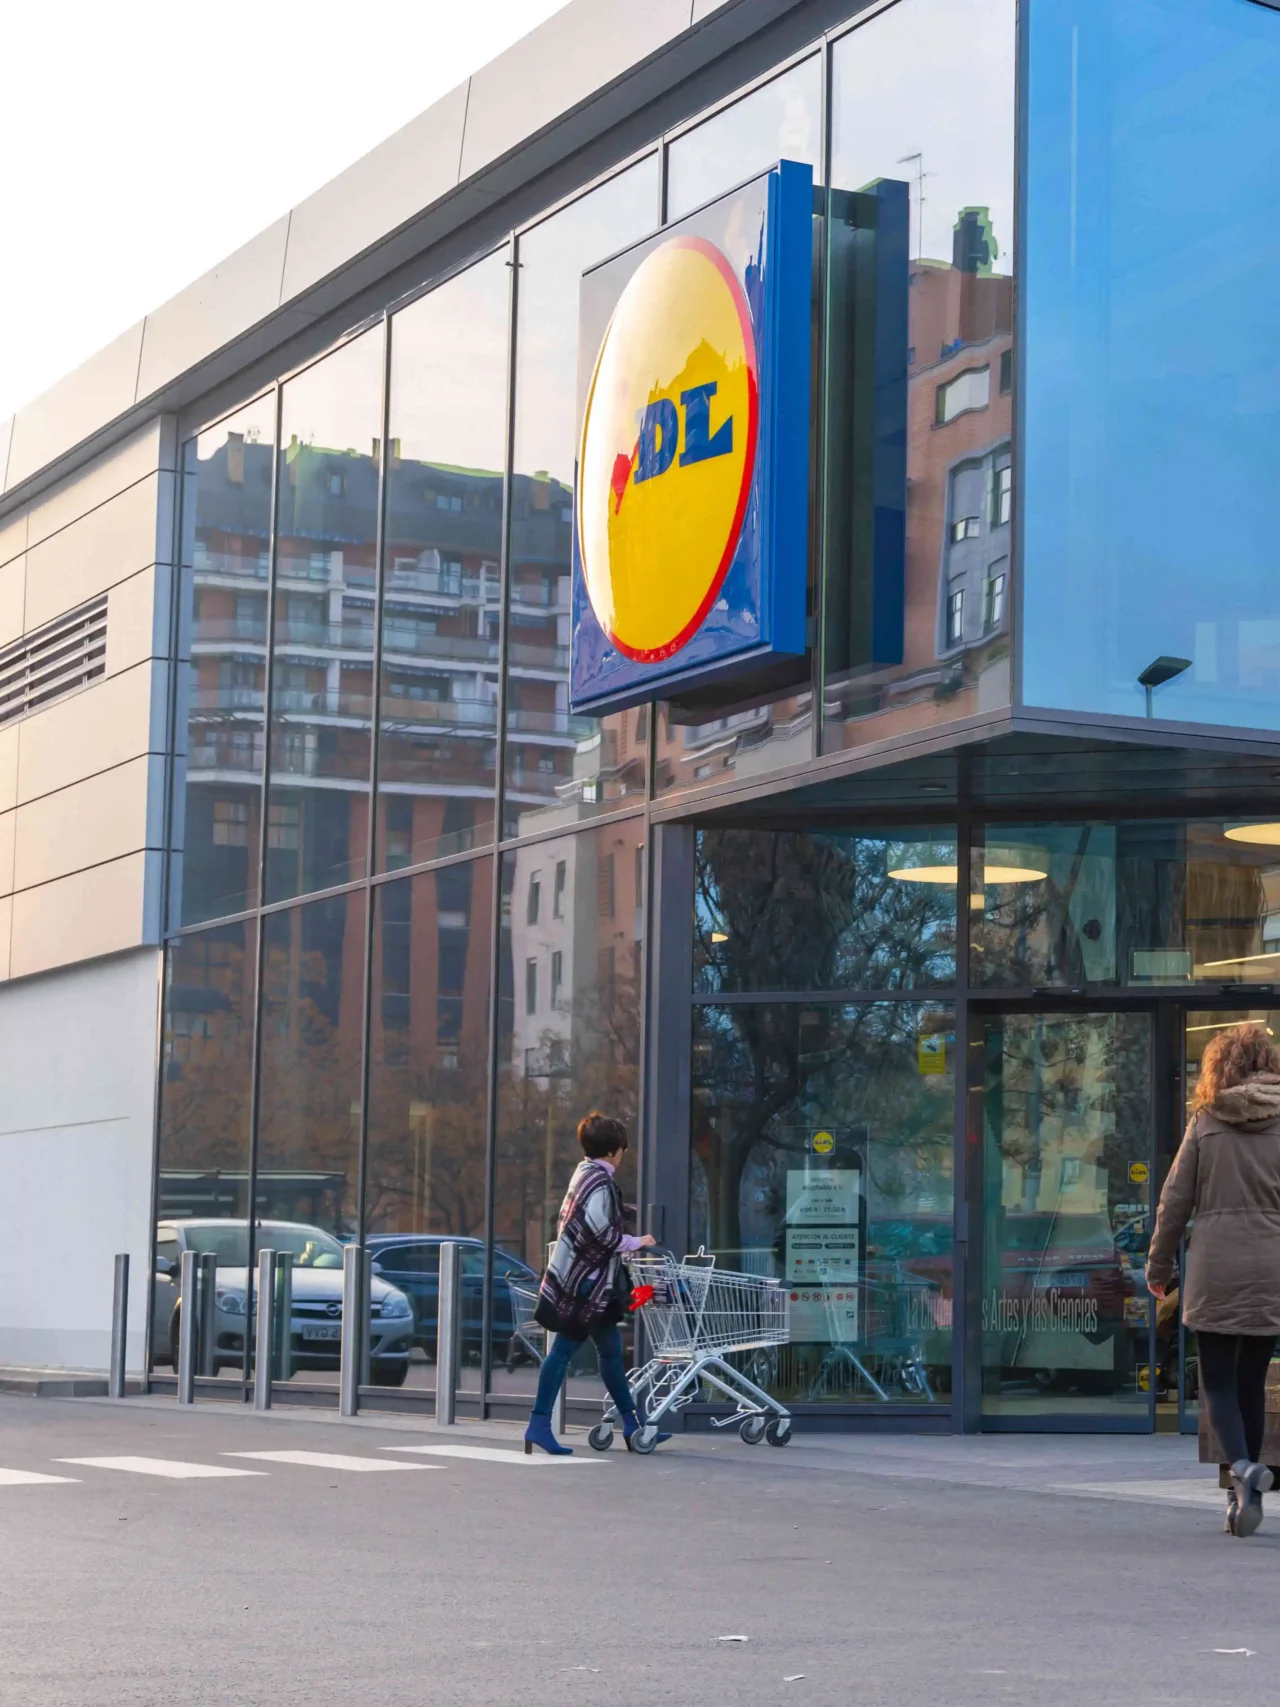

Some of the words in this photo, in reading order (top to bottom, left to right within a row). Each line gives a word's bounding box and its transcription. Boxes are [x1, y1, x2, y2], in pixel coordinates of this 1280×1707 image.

[991, 1288, 1018, 1332] Artes
[1022, 1299, 1031, 1339] y
[1032, 1288, 1046, 1332] las
[1050, 1288, 1097, 1333] Ciencias
